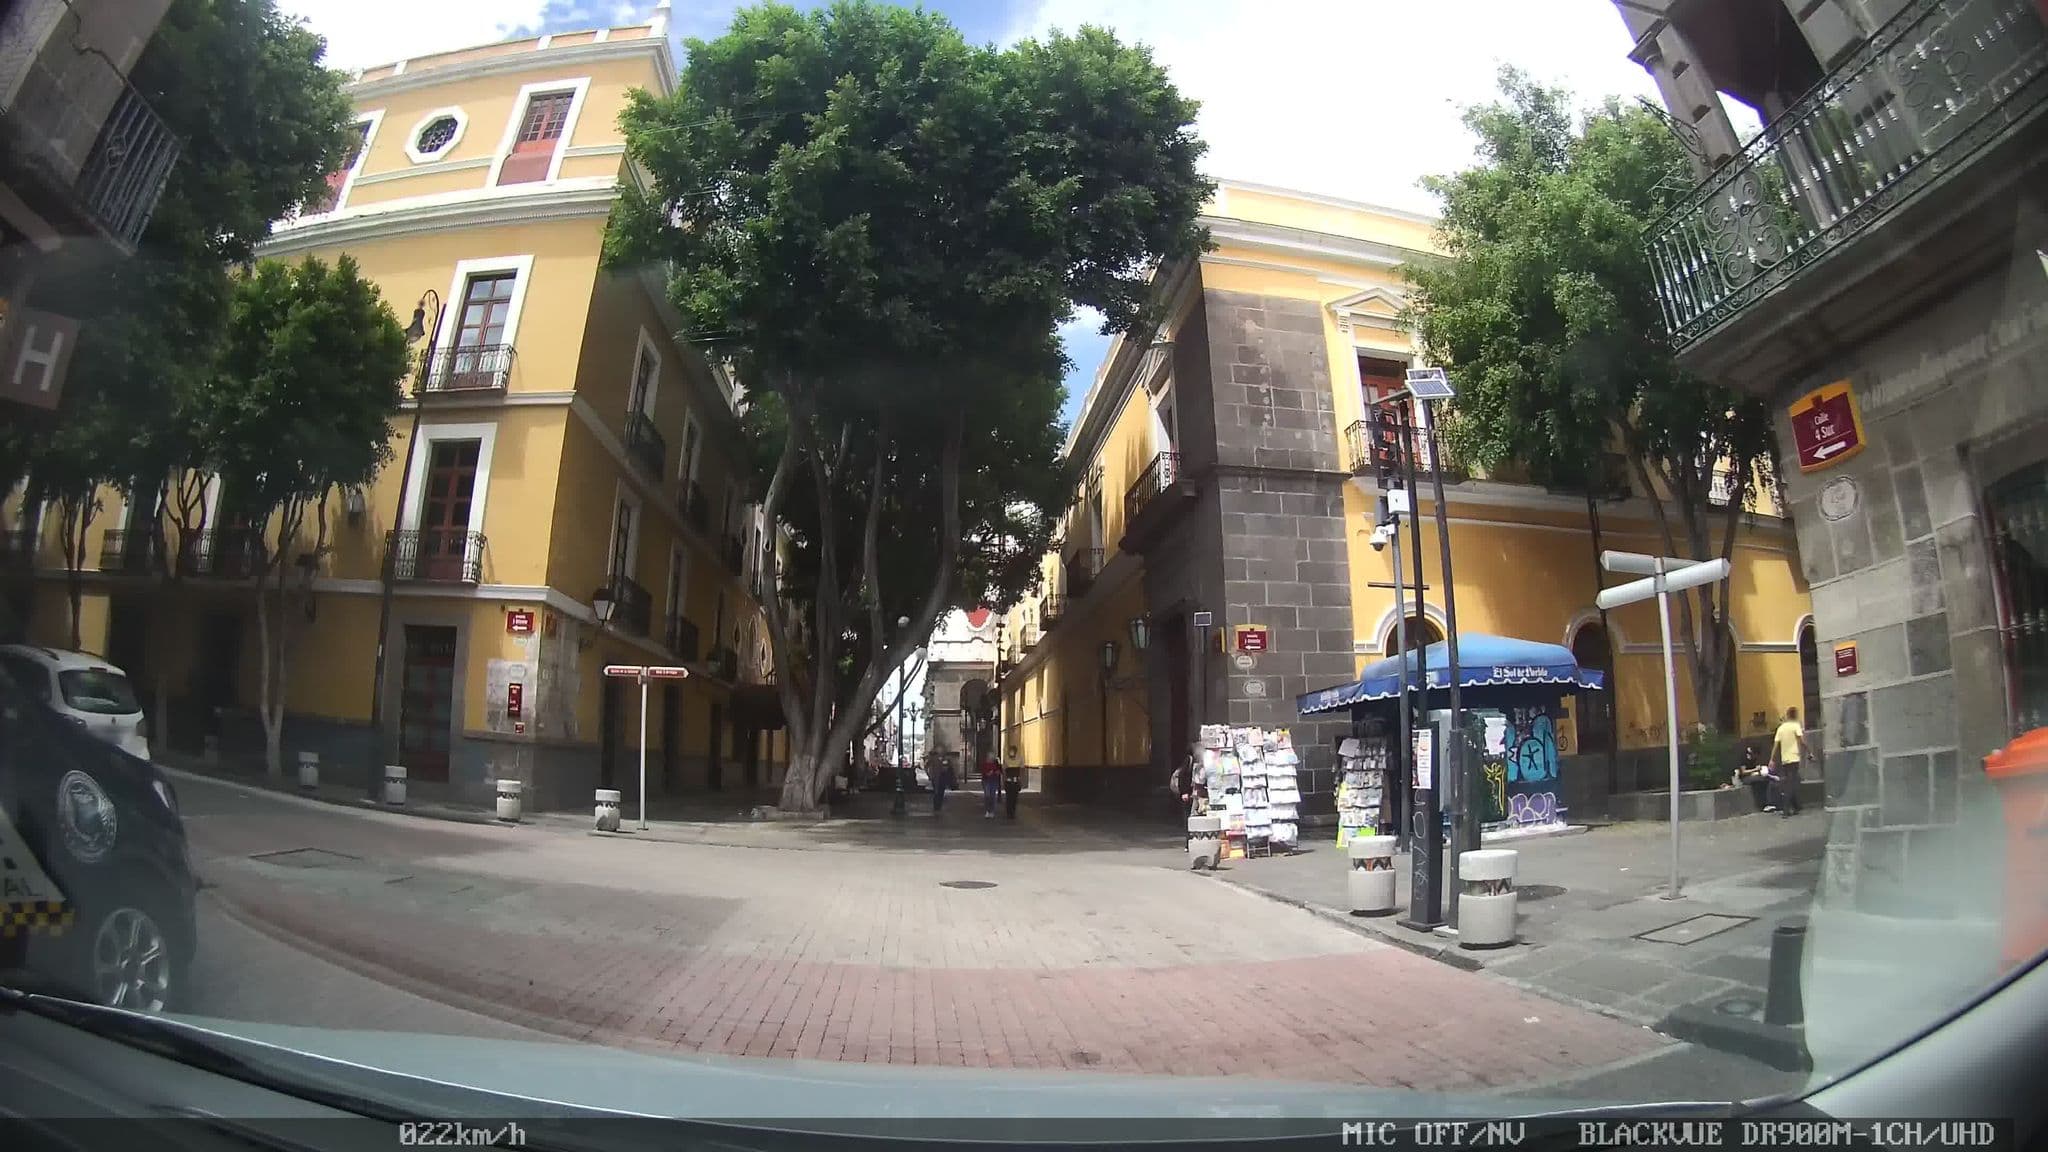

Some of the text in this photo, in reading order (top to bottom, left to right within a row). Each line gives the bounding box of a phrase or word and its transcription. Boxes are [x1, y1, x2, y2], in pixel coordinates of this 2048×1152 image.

[13, 325, 64, 392] H
[1815, 412, 1829, 425] Calle
[1821, 425, 1835, 438] Sur
[1493, 667, 1502, 678] El
[1503, 667, 1516, 677] Sol
